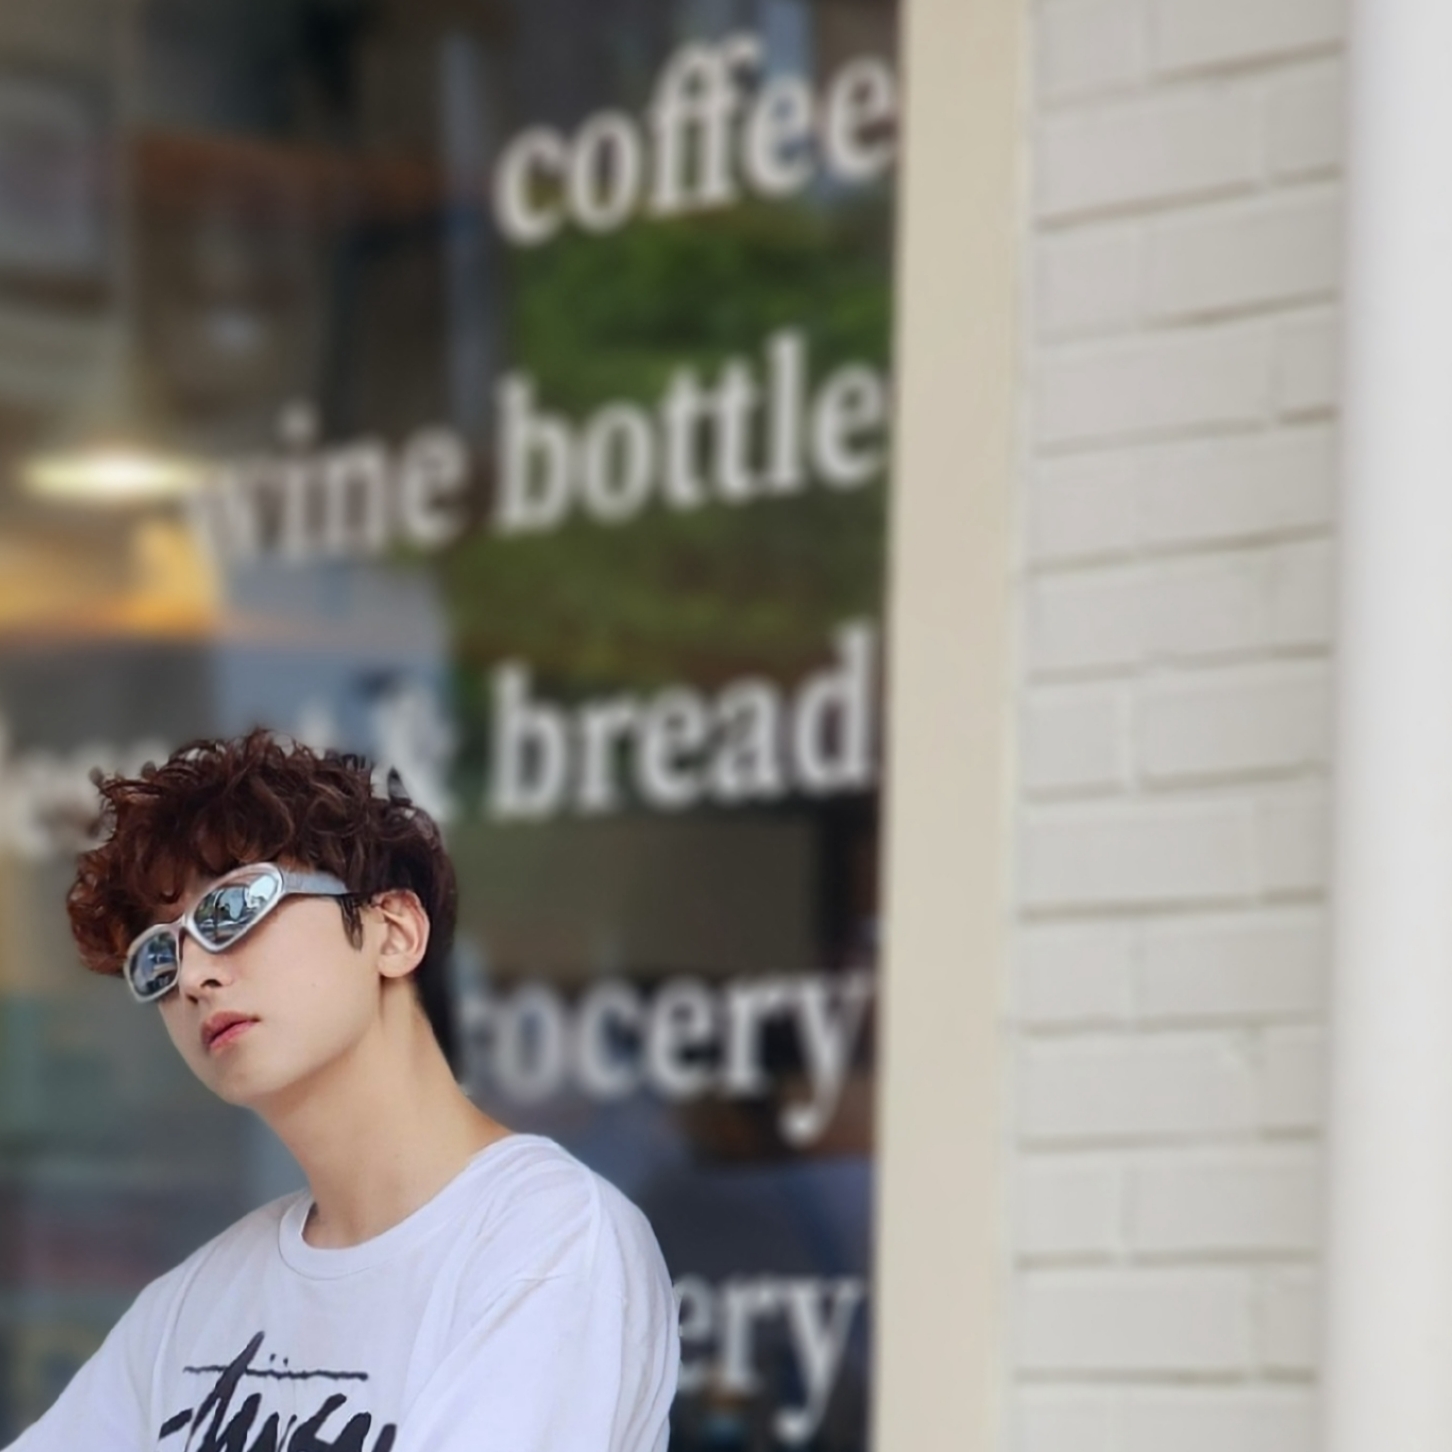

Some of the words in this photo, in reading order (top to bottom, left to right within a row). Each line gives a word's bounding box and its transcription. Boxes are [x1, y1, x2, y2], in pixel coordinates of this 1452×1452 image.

[492, 34, 896, 244] coffee
[186, 402, 466, 562] wine
[490, 328, 889, 536] bottle
[486, 618, 876, 818] bread
[454, 972, 870, 1144] rocery
